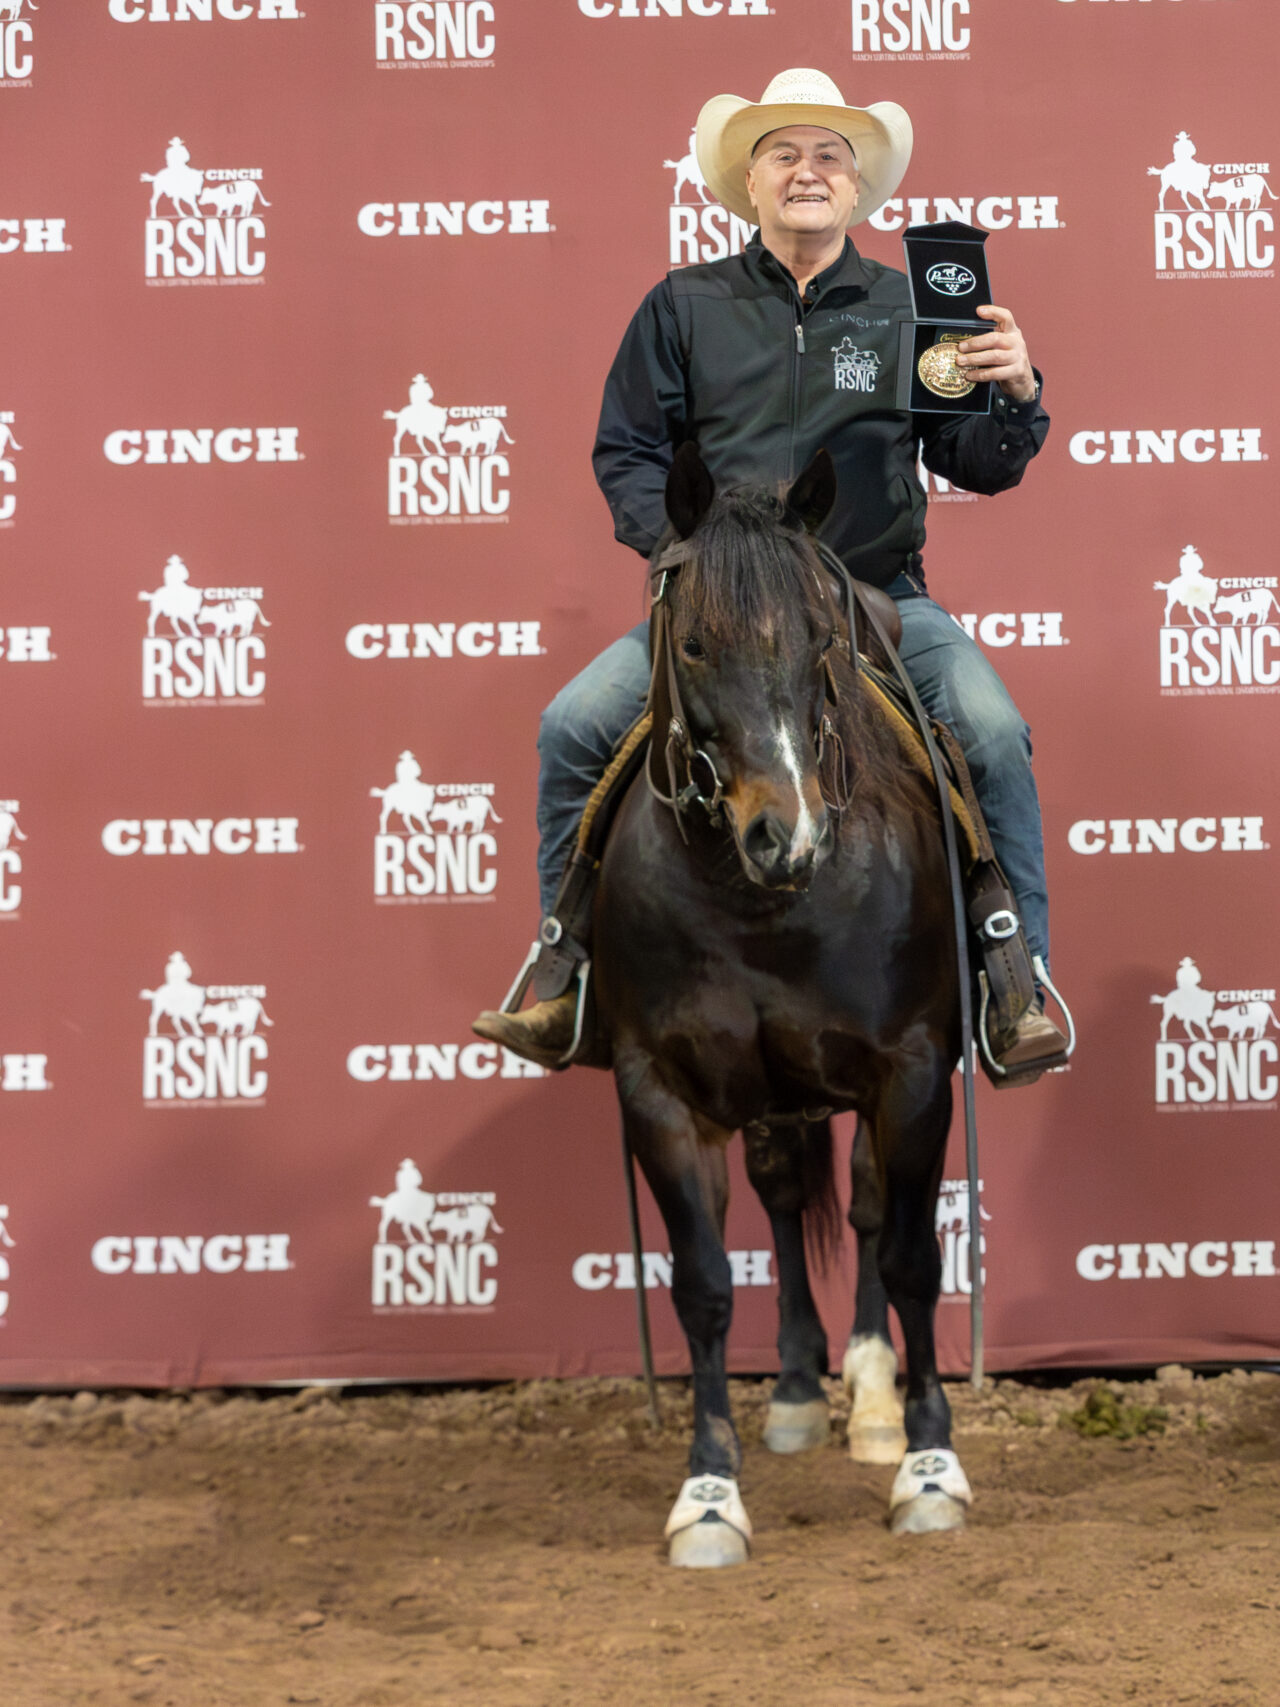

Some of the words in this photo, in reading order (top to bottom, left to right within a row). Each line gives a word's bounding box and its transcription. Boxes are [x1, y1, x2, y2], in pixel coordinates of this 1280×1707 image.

[108, 0, 299, 23] CINCH
[851, 0, 970, 53] RSNC
[374, 4, 495, 60] RSNC
[1213, 163, 1270, 174] CINCH
[357, 200, 550, 237] CINCH
[868, 197, 1061, 232] CINCH
[145, 217, 266, 277] RSNC
[669, 206, 759, 265] RSN
[1154, 211, 1275, 269] RSNC
[835, 370, 875, 392] RSNC
[449, 406, 507, 418] CINCH
[103, 427, 300, 465] CINCH
[1069, 428, 1262, 464] CINCH
[388, 456, 510, 515] RSNC
[1220, 576, 1278, 588] CINCH
[345, 621, 541, 659] CINCH
[142, 636, 266, 698] RSNC
[101, 817, 300, 856] CINCH
[1068, 816, 1264, 855] CINCH
[374, 834, 498, 895] RSNC
[1216, 989, 1276, 1002] CINCH
[142, 1037, 268, 1099] RSNC
[346, 1043, 543, 1082] CINCH
[1155, 1041, 1279, 1103] RSNC
[91, 1234, 290, 1274] CINCH
[572, 1250, 772, 1290] CINH
[1076, 1241, 1275, 1281] CINCH
[371, 1244, 498, 1306] RSNC
